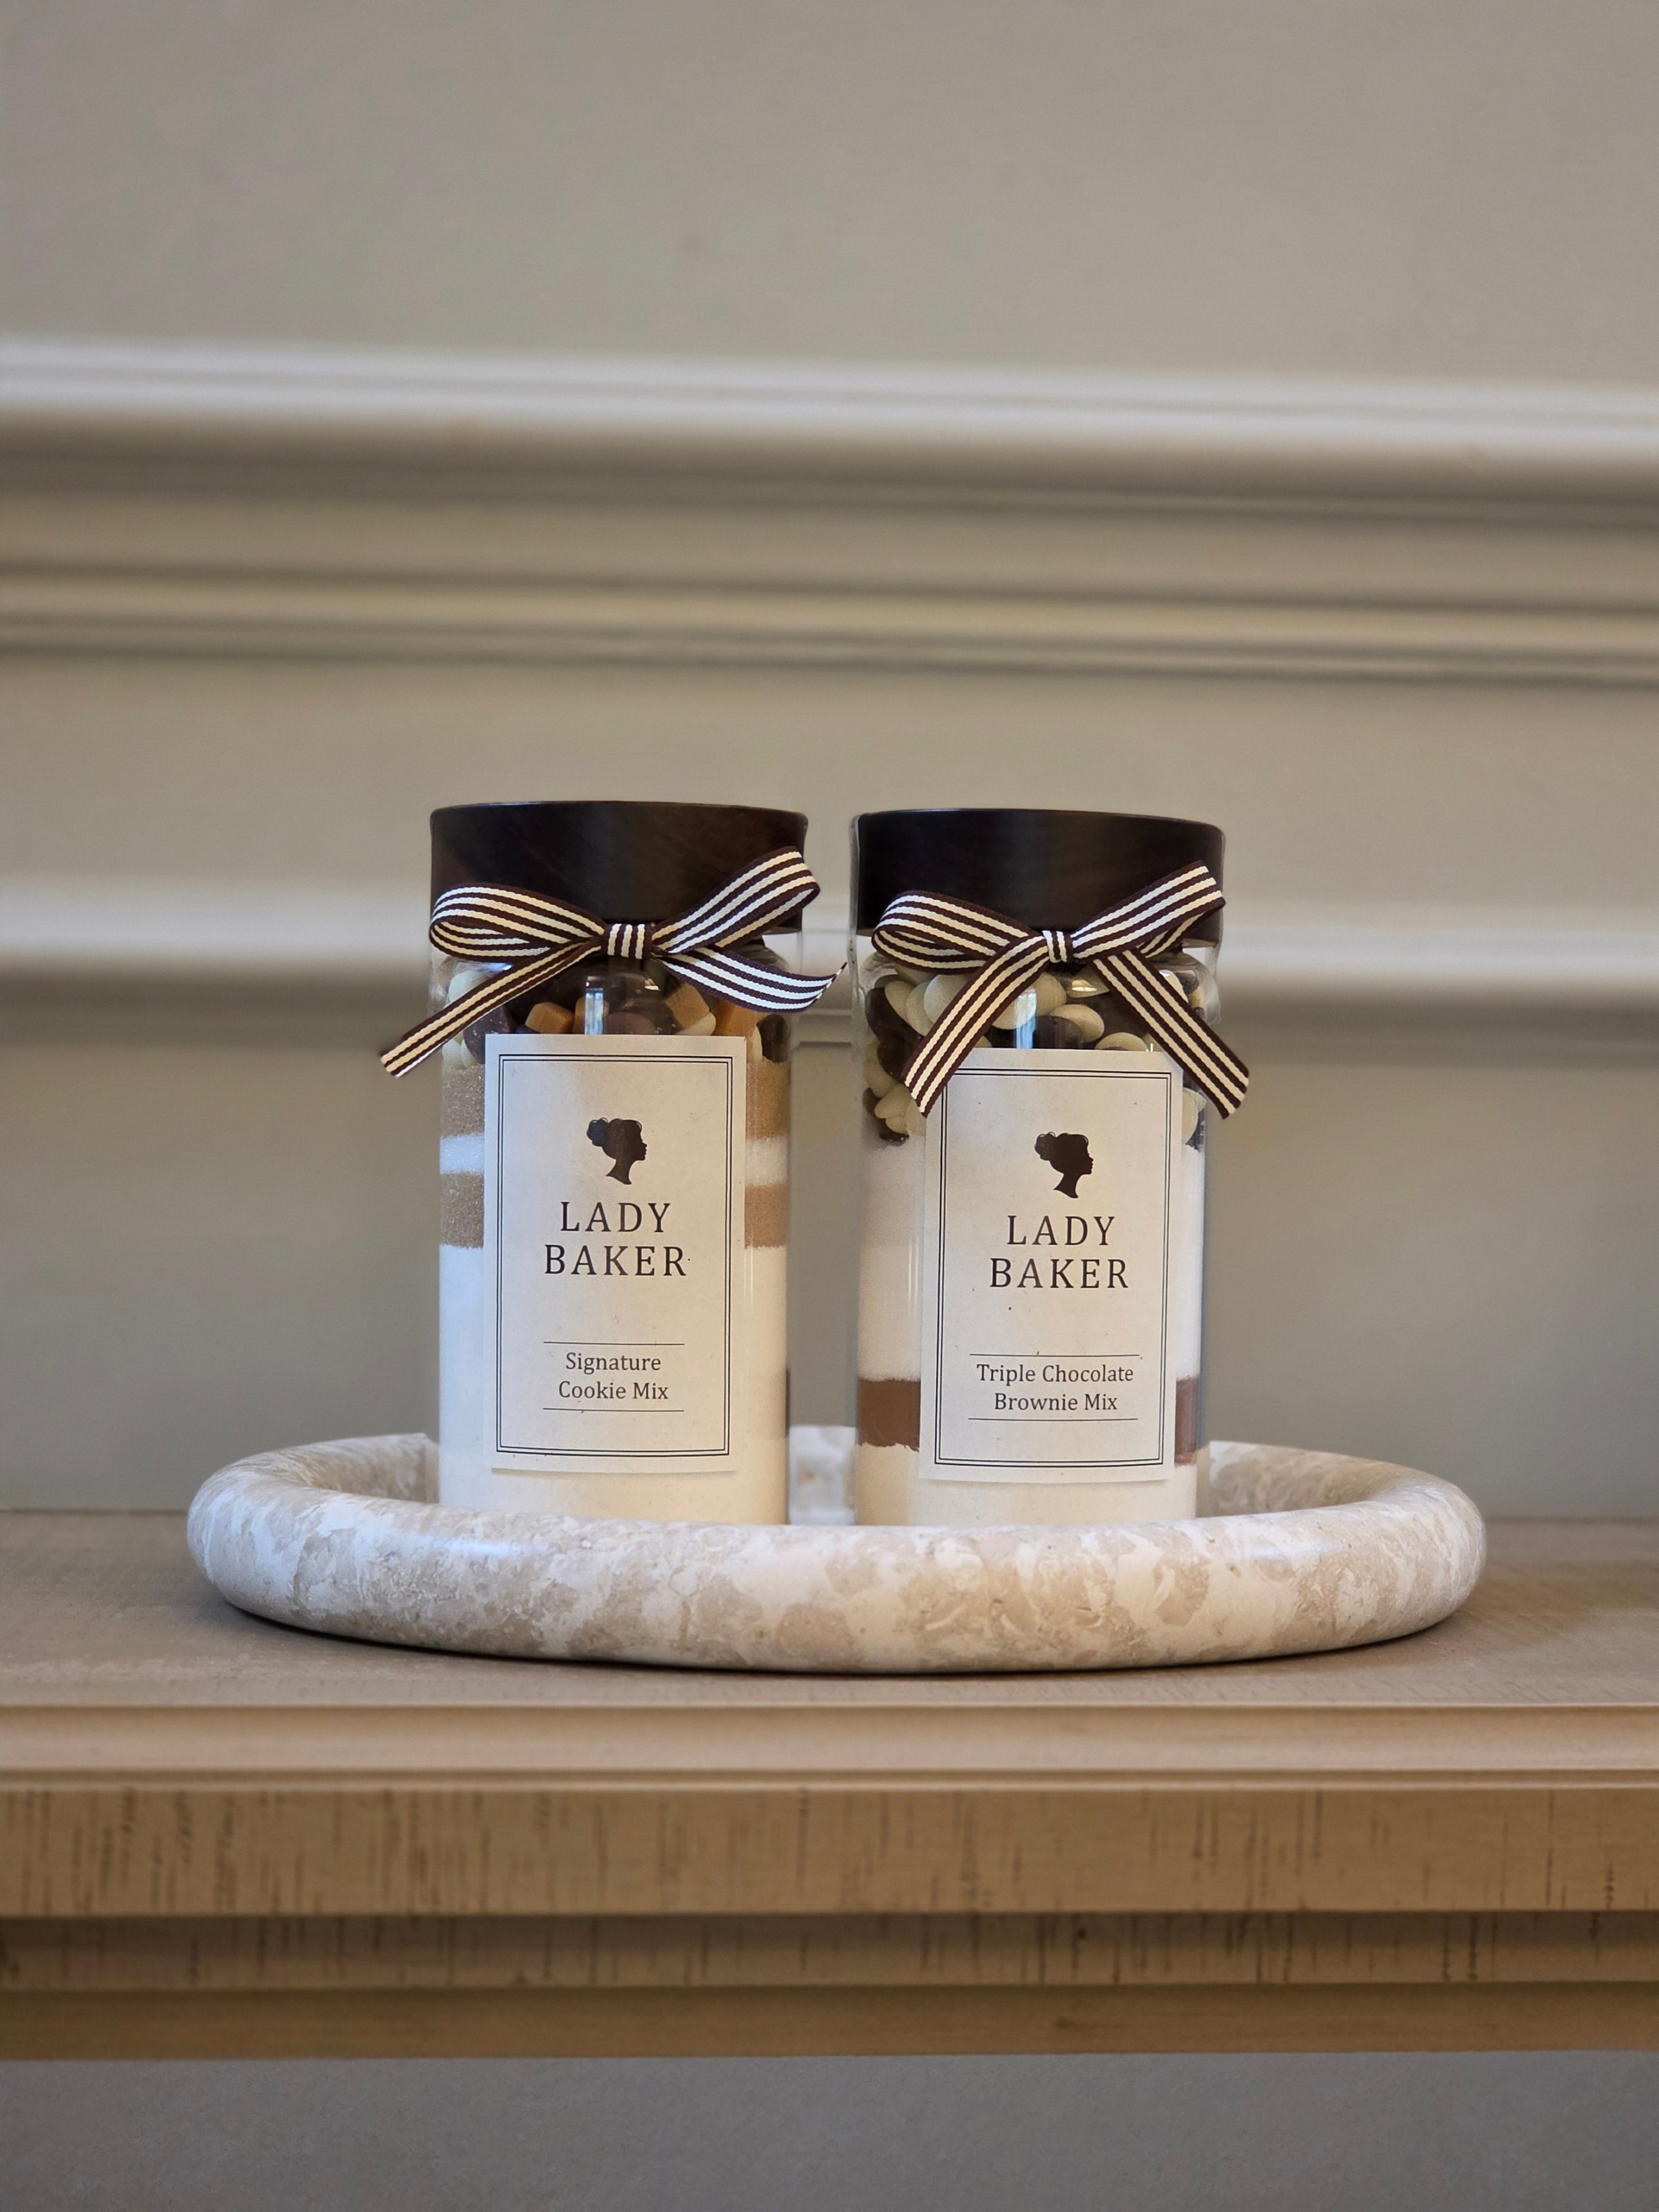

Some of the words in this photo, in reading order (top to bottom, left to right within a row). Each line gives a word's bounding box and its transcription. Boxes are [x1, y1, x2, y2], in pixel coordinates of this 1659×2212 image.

[560, 1201, 671, 1233] LADY
[1006, 1215, 1115, 1246] LADY
[545, 1244, 687, 1276] BAKER
[989, 1258, 1129, 1288] BAKER
[566, 1352, 661, 1375] Signature
[977, 1363, 1036, 1386] Triple
[1042, 1364, 1134, 1383] Chocolate
[559, 1380, 626, 1399] Cookie
[633, 1382, 669, 1400] Mix
[994, 1392, 1078, 1411] Brownie
[1084, 1393, 1118, 1411] Mix
